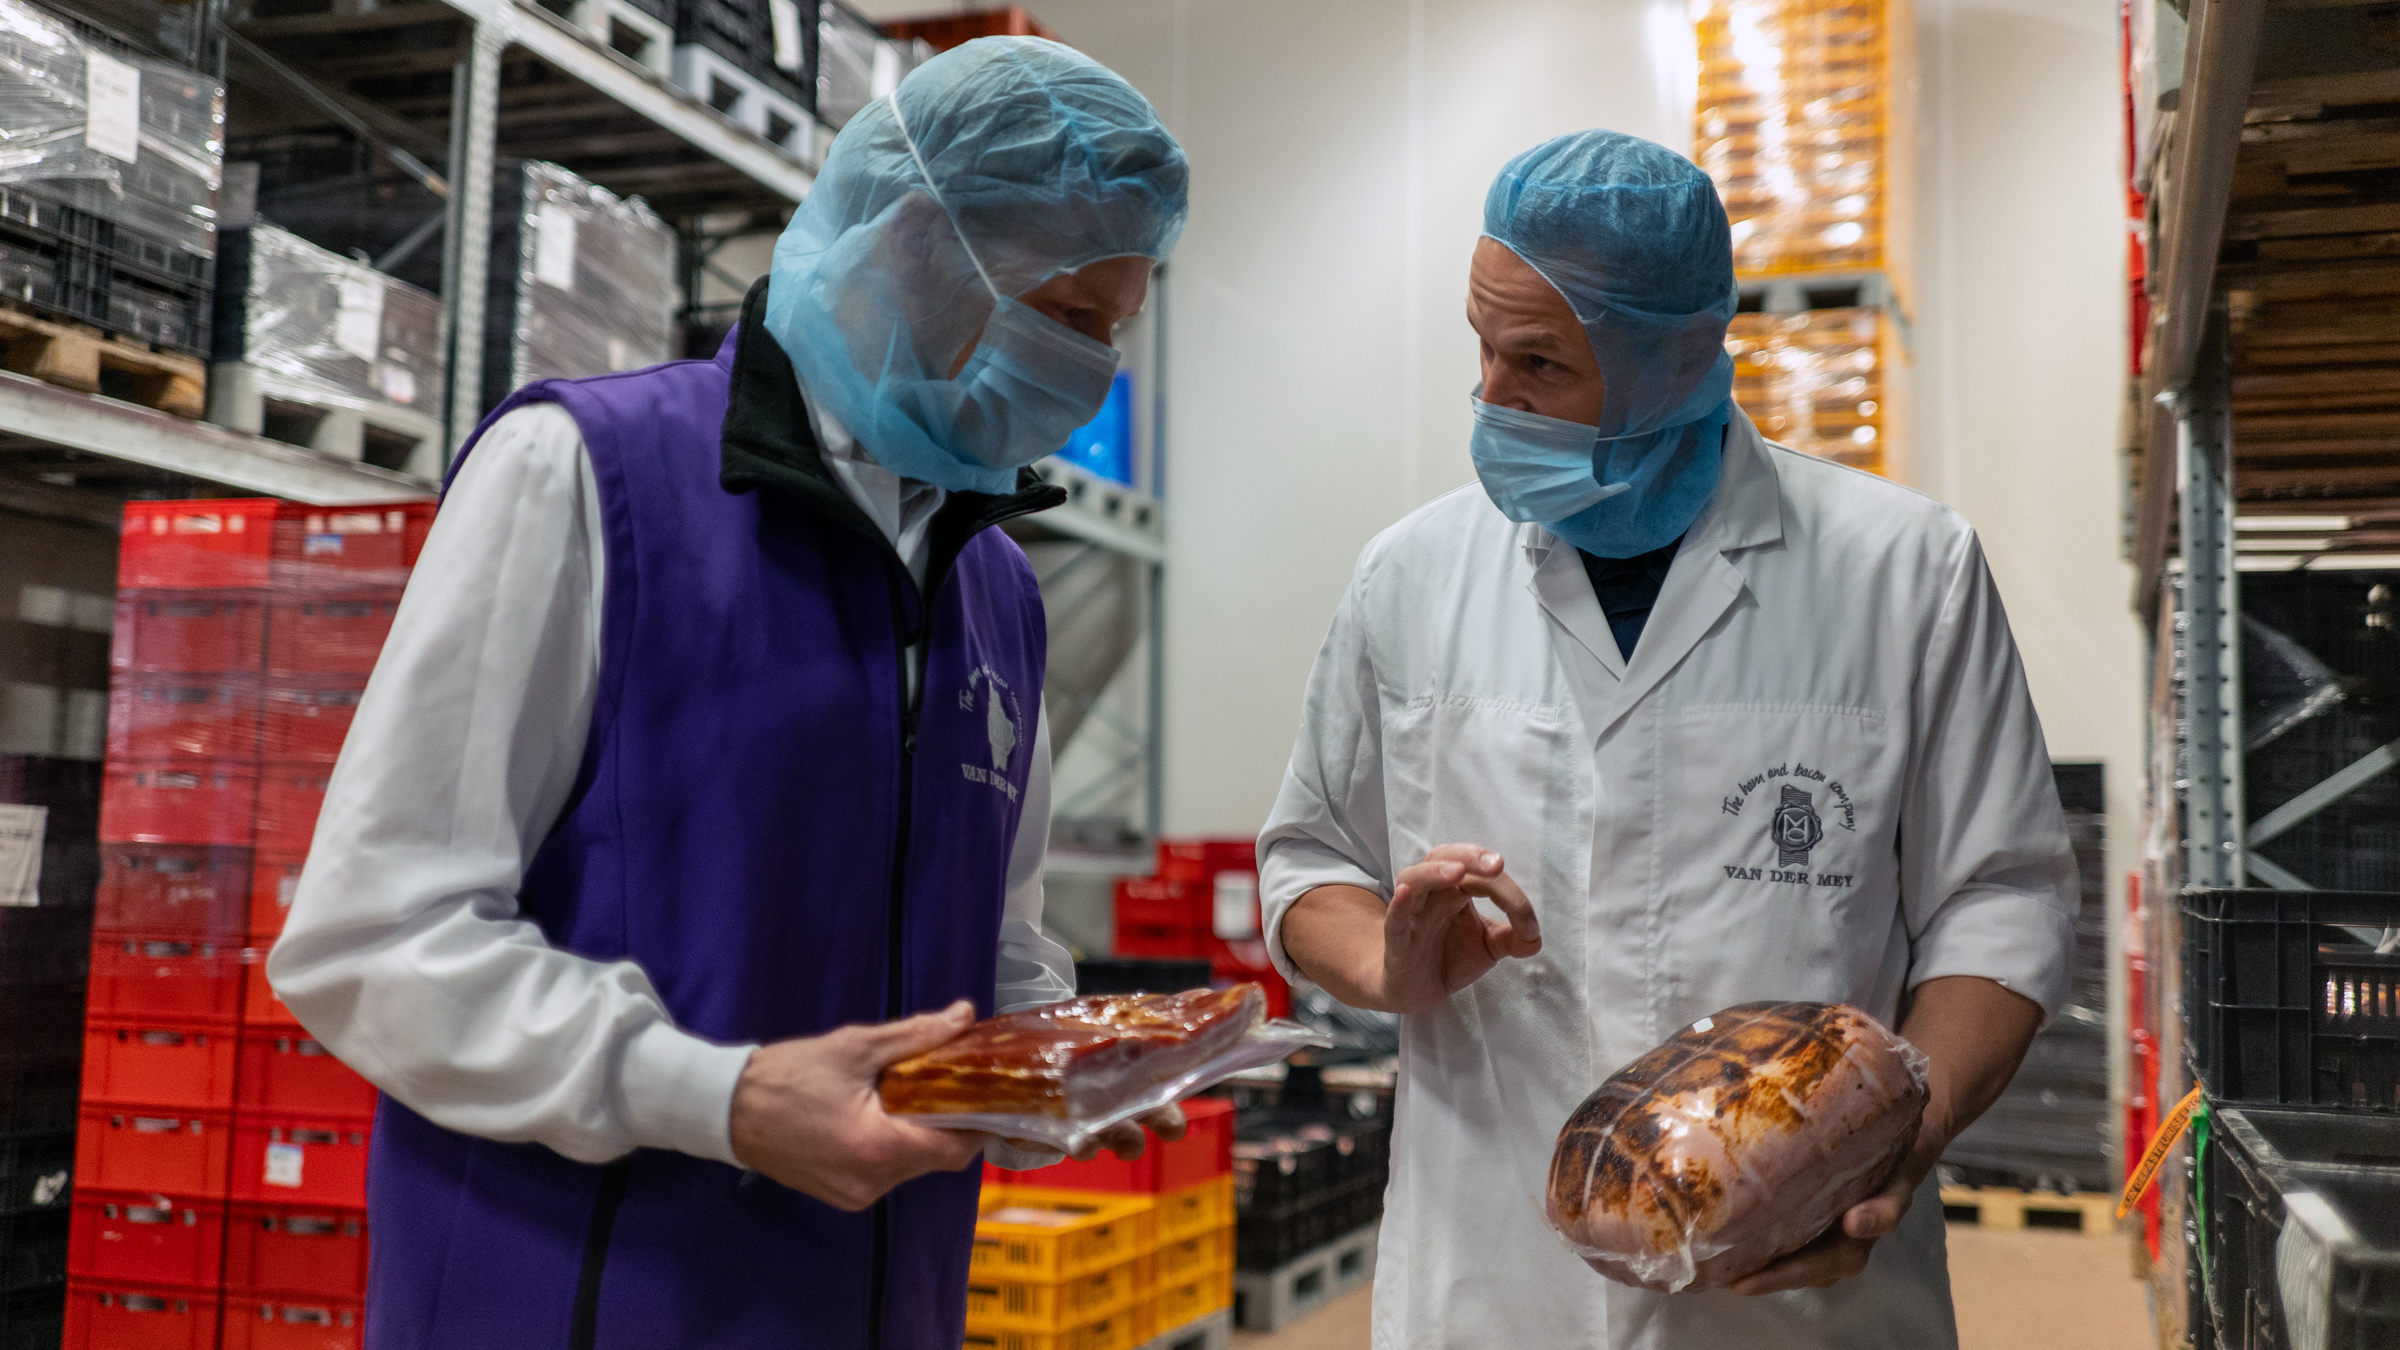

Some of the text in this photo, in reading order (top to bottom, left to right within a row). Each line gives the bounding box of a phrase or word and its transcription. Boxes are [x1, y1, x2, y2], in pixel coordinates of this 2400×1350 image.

[961, 763, 987, 784] VAN
[1722, 762, 1856, 832] The ham and bacon company
[1723, 865, 1853, 887] VAN DER MEY
